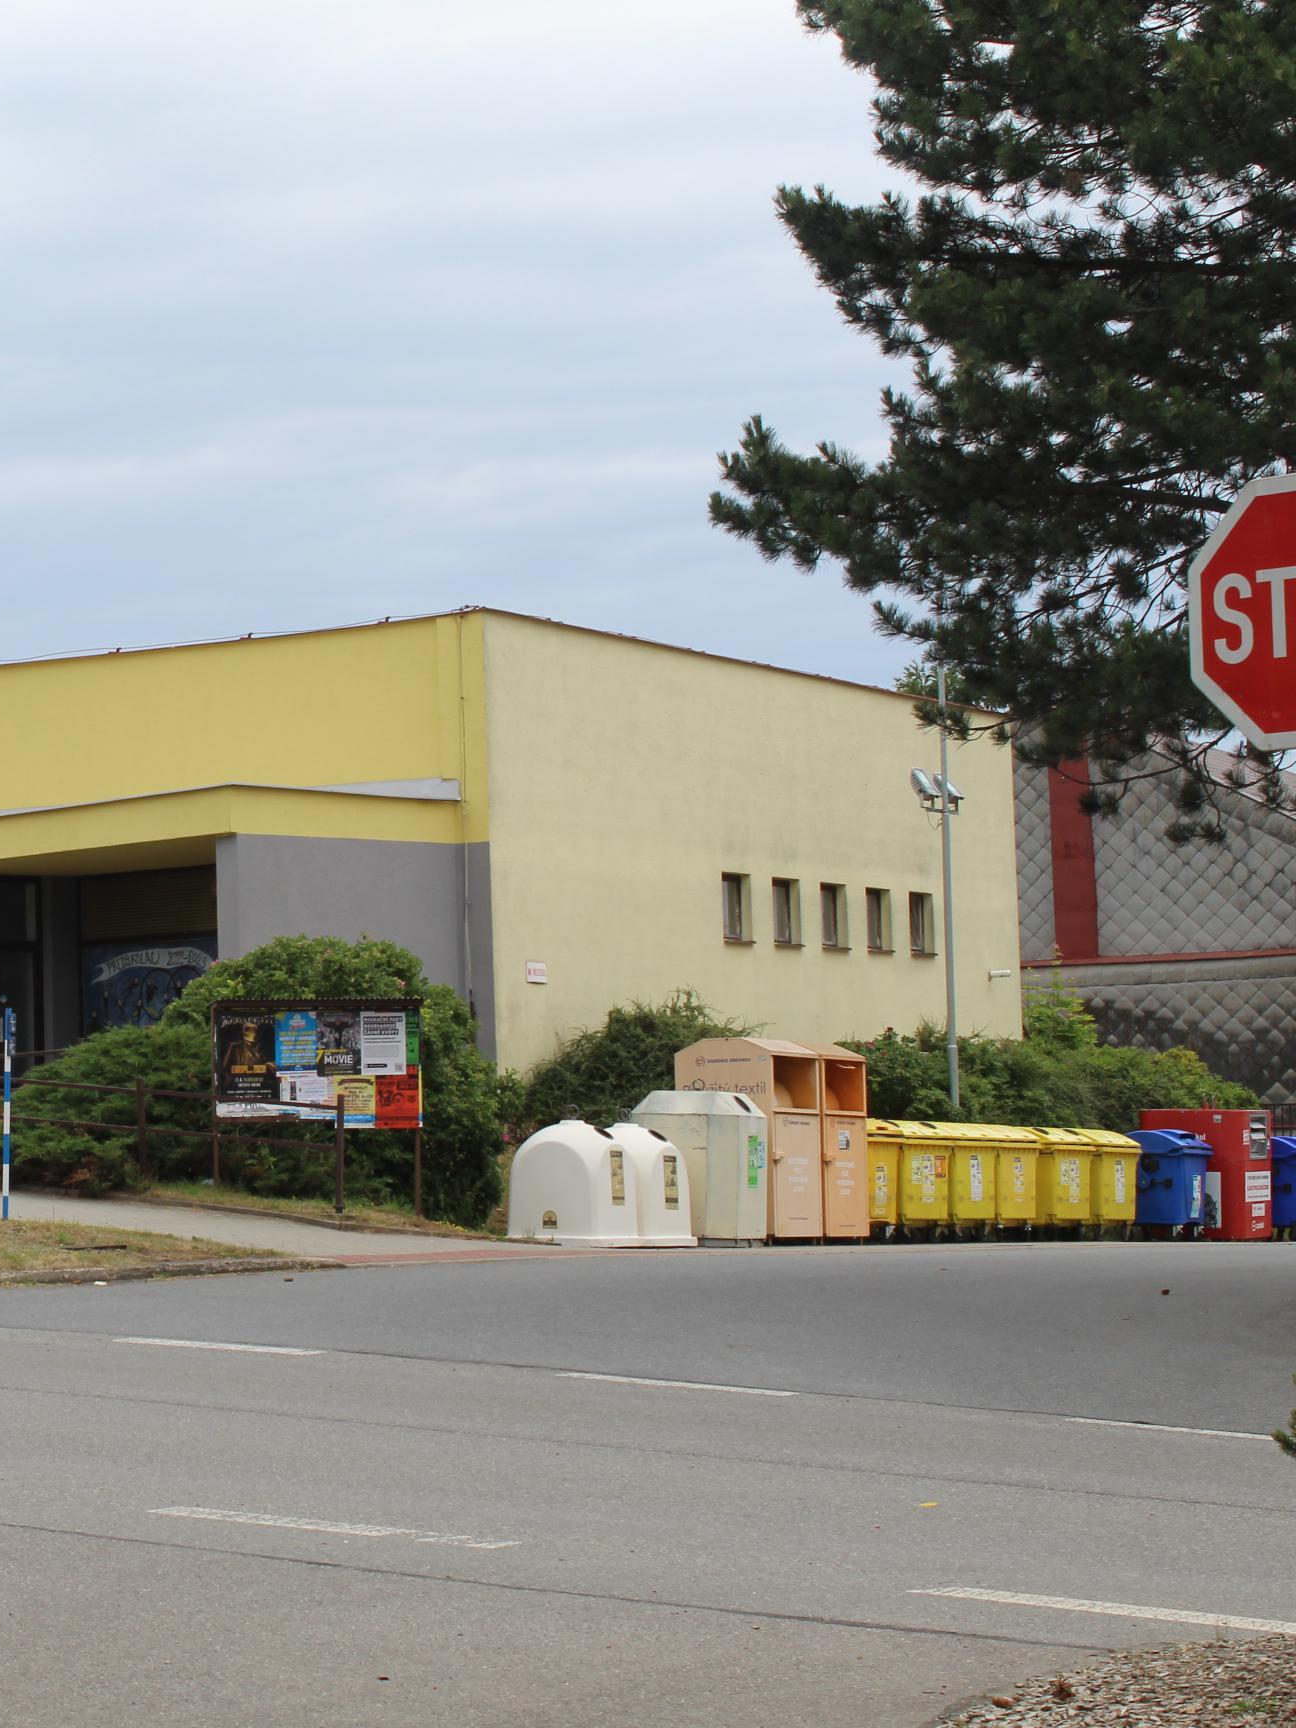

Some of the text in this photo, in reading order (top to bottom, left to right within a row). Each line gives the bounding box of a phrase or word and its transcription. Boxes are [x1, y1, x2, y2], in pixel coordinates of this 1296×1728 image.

[1213, 565, 1296, 665] ST
[324, 1054, 354, 1064] MOVIE
[735, 1081, 766, 1095] textil
